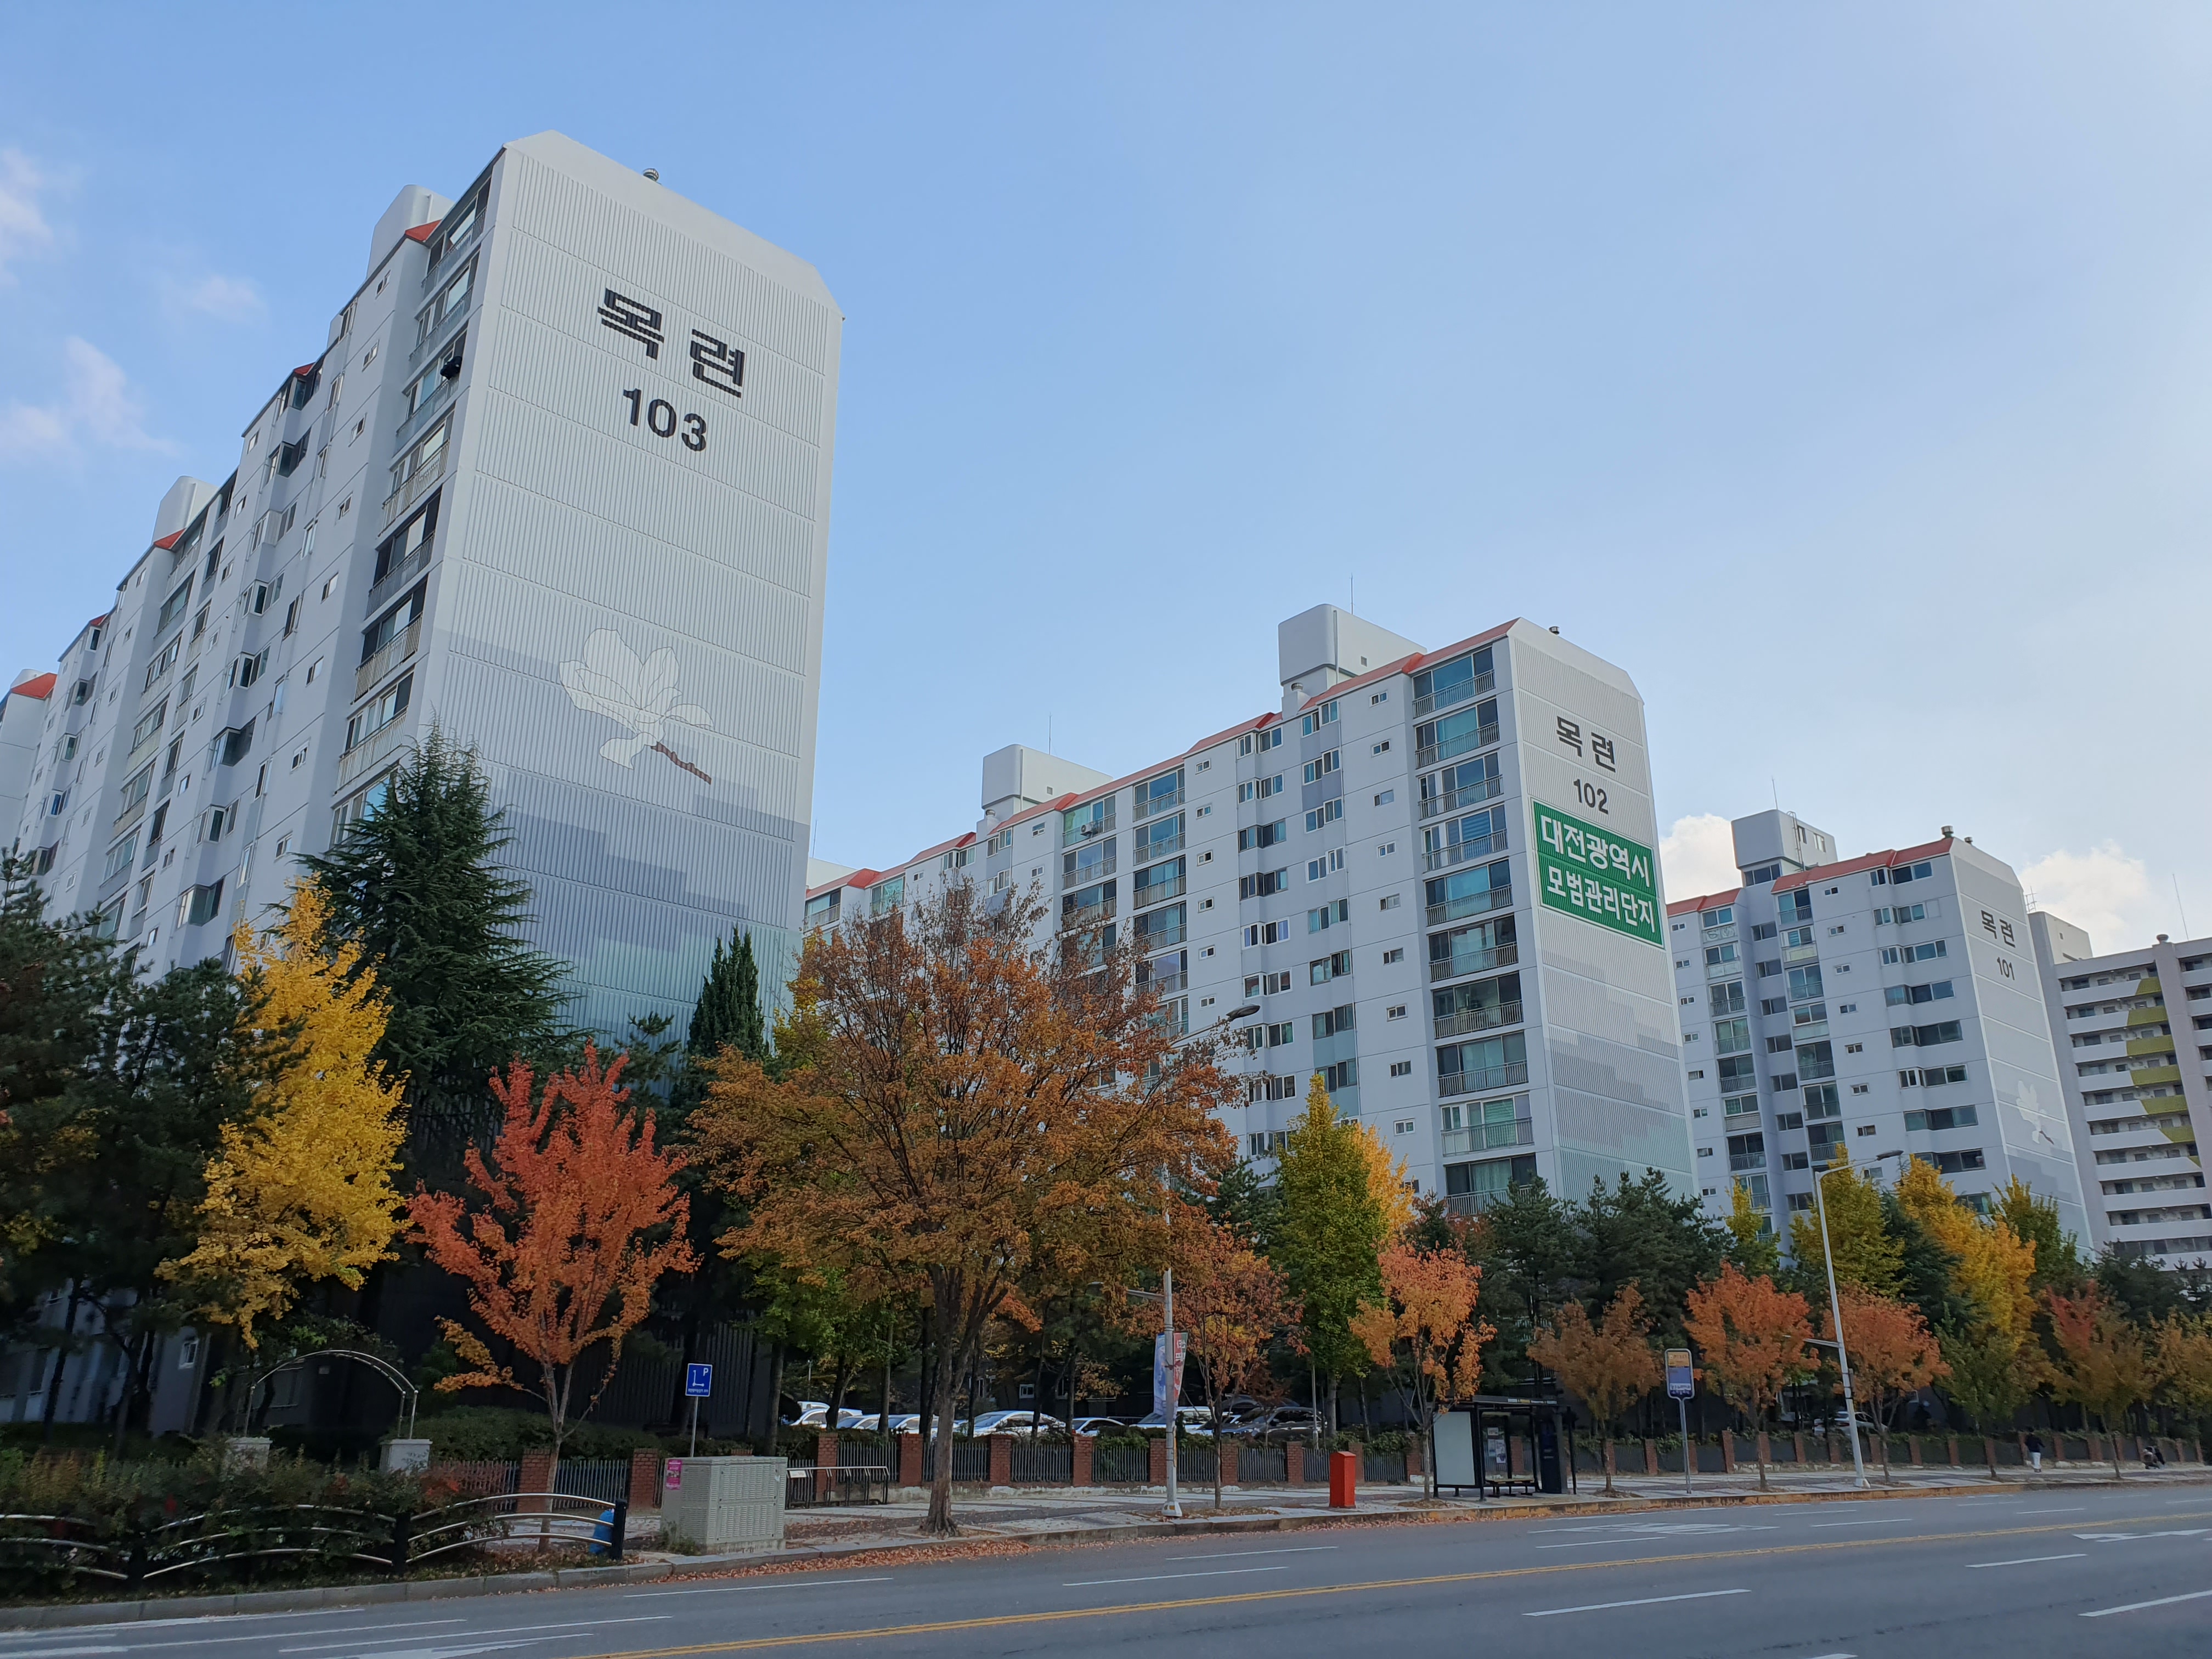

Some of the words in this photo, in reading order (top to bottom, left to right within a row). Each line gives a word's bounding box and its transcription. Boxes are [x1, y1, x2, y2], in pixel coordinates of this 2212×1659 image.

[623, 388, 707, 452] 103
[1573, 778, 1609, 815] 102
[1541, 815, 1650, 888] 대전광역시
[1547, 866, 1655, 933] 모범관리단지
[1997, 957, 2015, 980] 101
[703, 1367, 709, 1376] P
